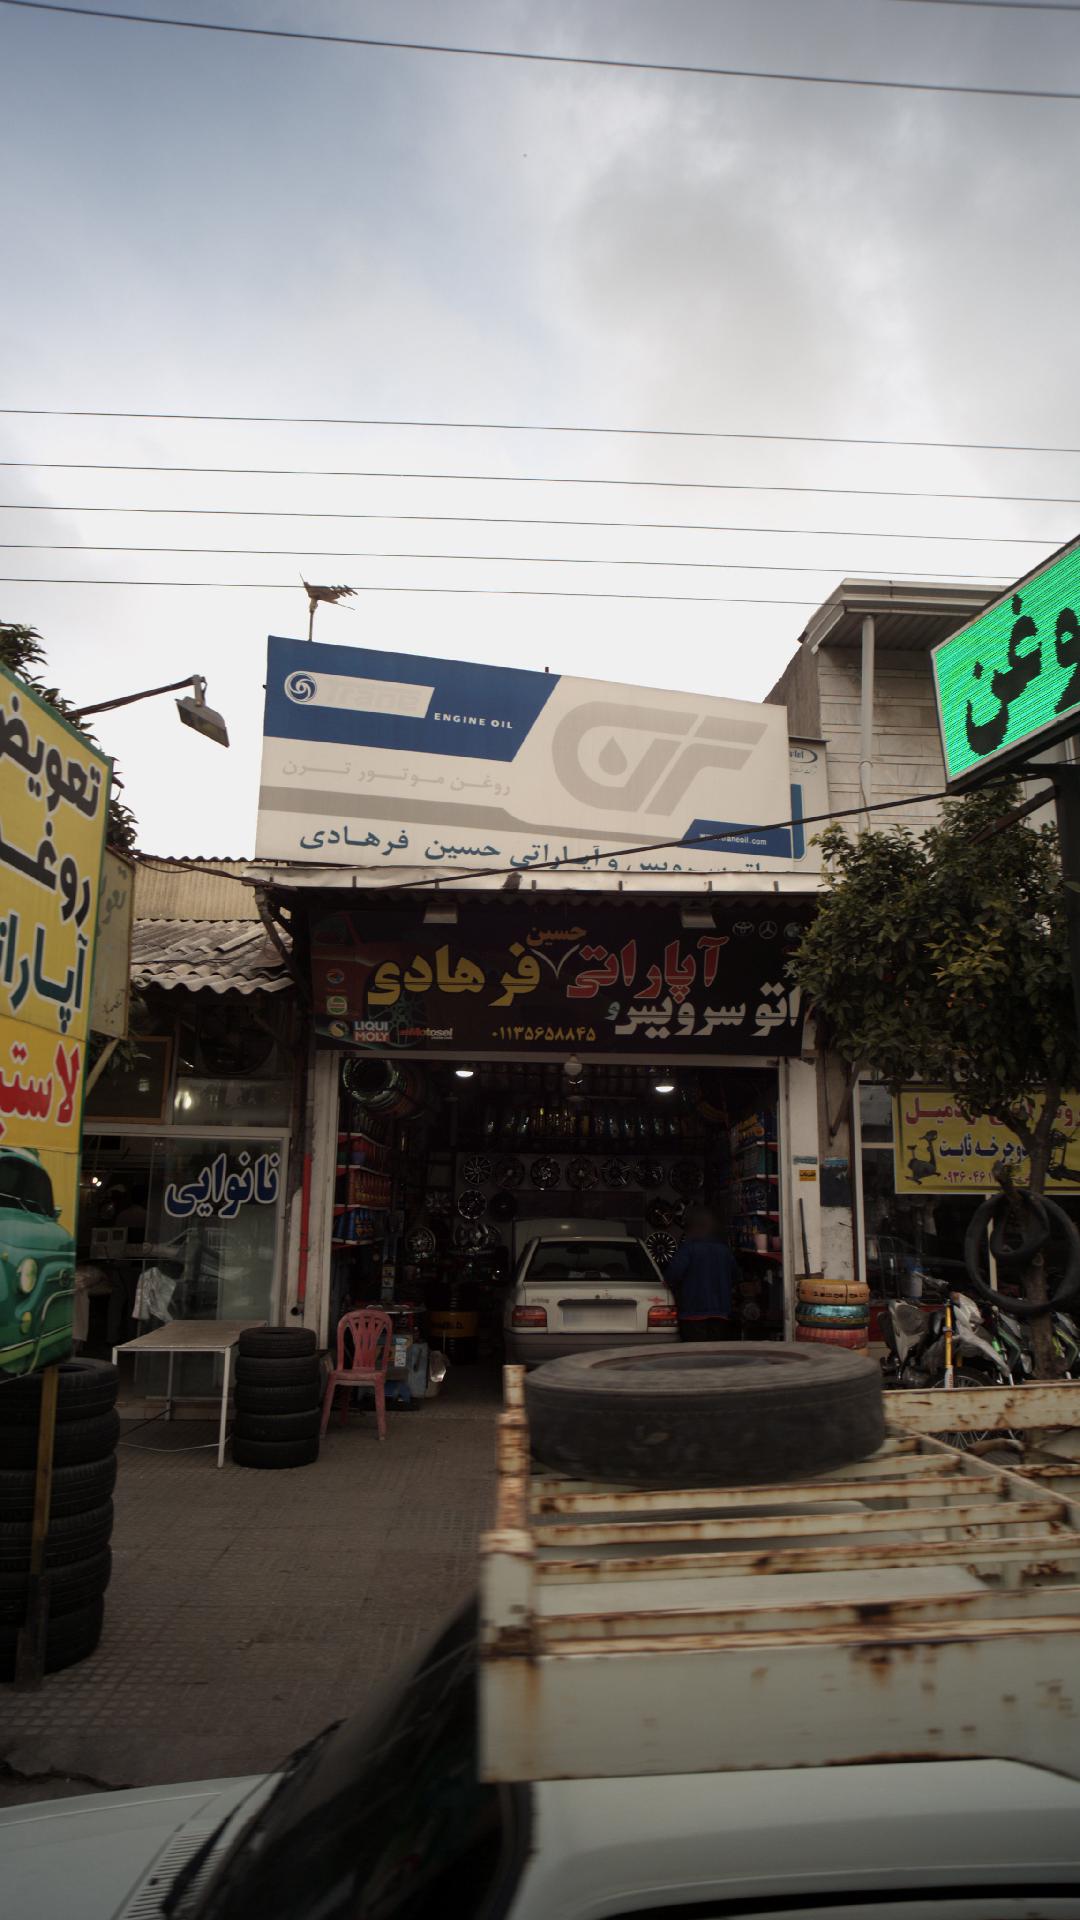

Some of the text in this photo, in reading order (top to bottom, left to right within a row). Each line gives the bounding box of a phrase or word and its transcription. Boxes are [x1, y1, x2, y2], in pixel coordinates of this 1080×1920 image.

[434, 712, 514, 729] ENGINE OIL
[282, 761, 512, 796] روغن موتور ترن
[299, 824, 409, 856] فرهادی
[424, 838, 502, 860] حسین
[0, 820, 91, 926] روغ
[525, 924, 588, 947] حسین
[367, 935, 730, 1008] آپاراتی فرهادی
[614, 996, 747, 1040] سرویس
[751, 981, 802, 1036] اتو
[353, 1020, 389, 1031] LIQUI
[353, 1031, 390, 1042] MOLY
[490, 1023, 597, 1043] ۰۱۱۳۵۶۵۸۸۴۵
[165, 1151, 280, 1218] نانوایی
